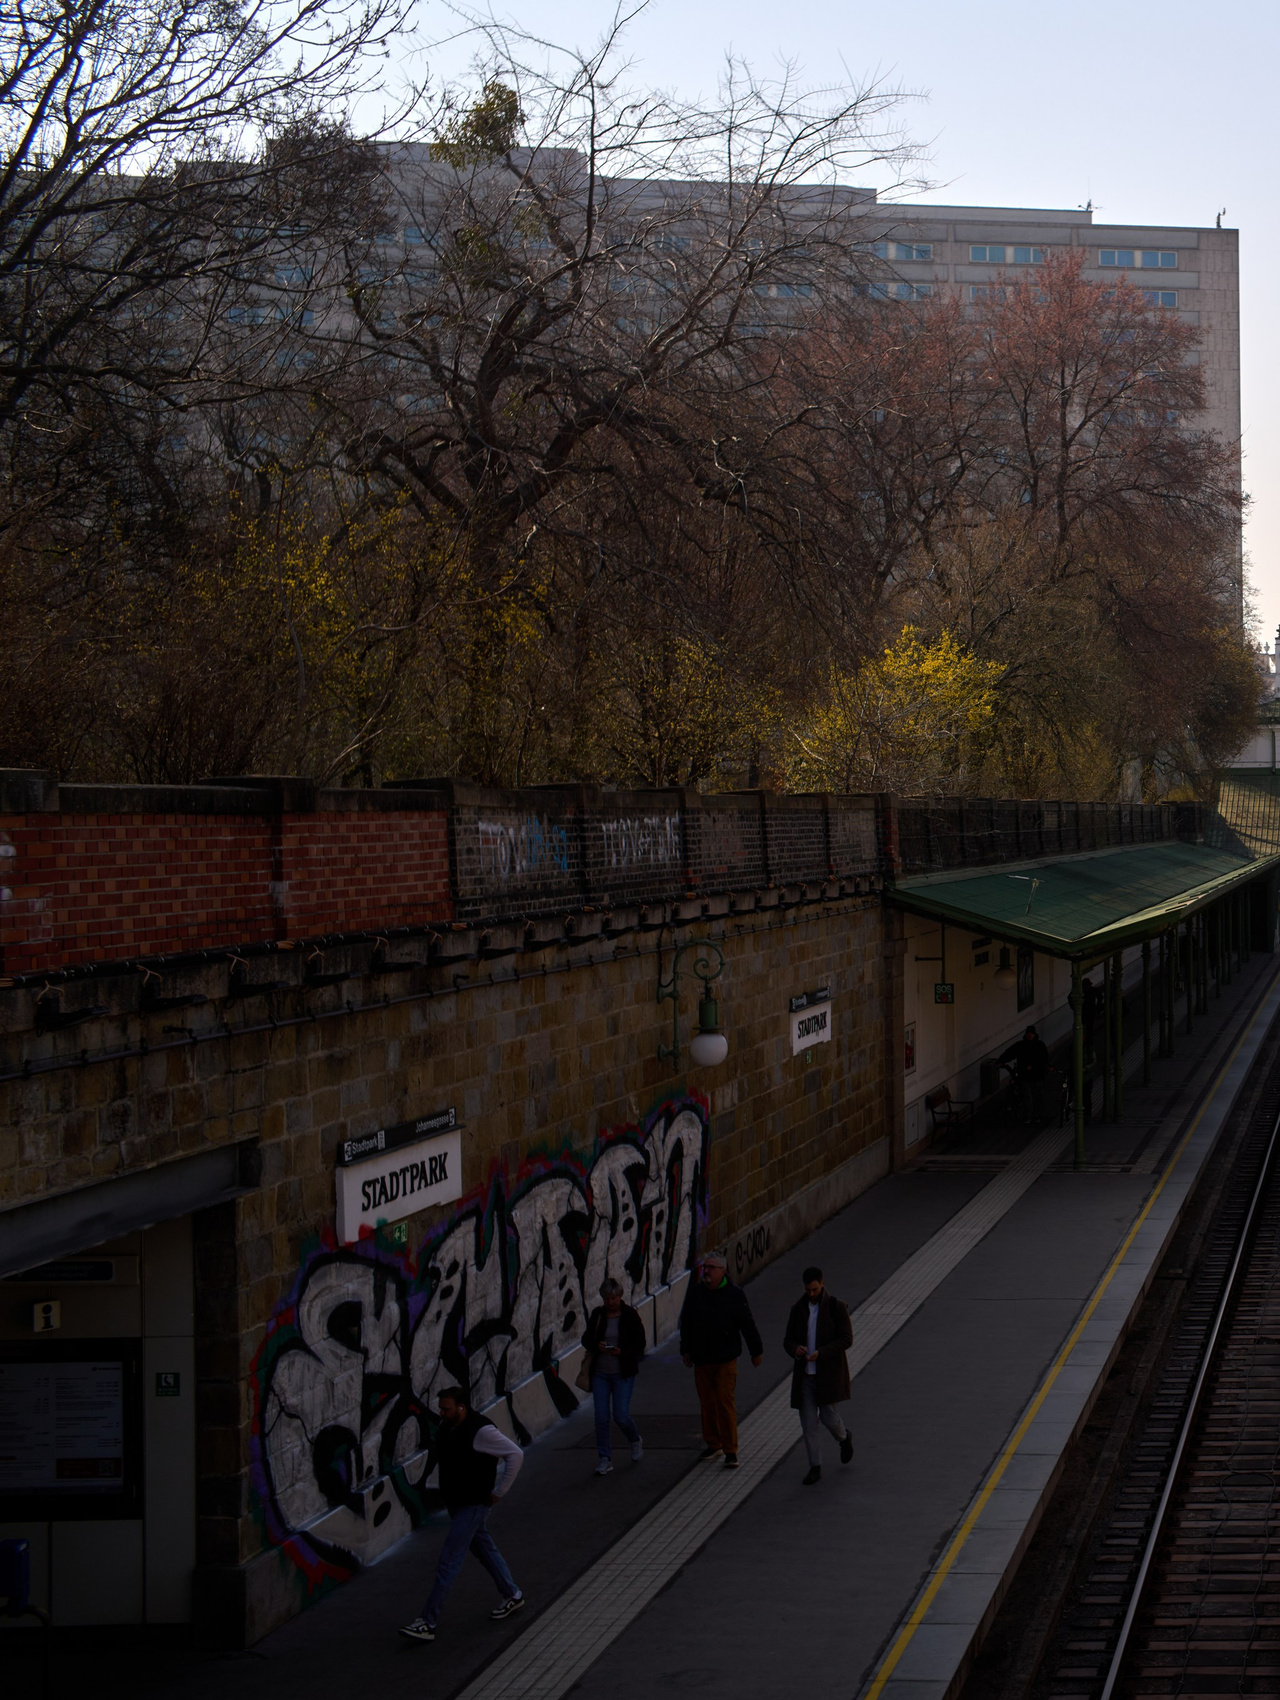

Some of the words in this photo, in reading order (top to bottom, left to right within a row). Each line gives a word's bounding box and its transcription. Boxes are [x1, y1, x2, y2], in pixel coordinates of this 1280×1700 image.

[936, 985, 952, 994] SOS
[797, 1010, 828, 1039] STADTPARK
[416, 1113, 450, 1133] Johannesgasse
[351, 1134, 379, 1154] Stadtpark
[361, 1152, 449, 1212] STADTPARK
